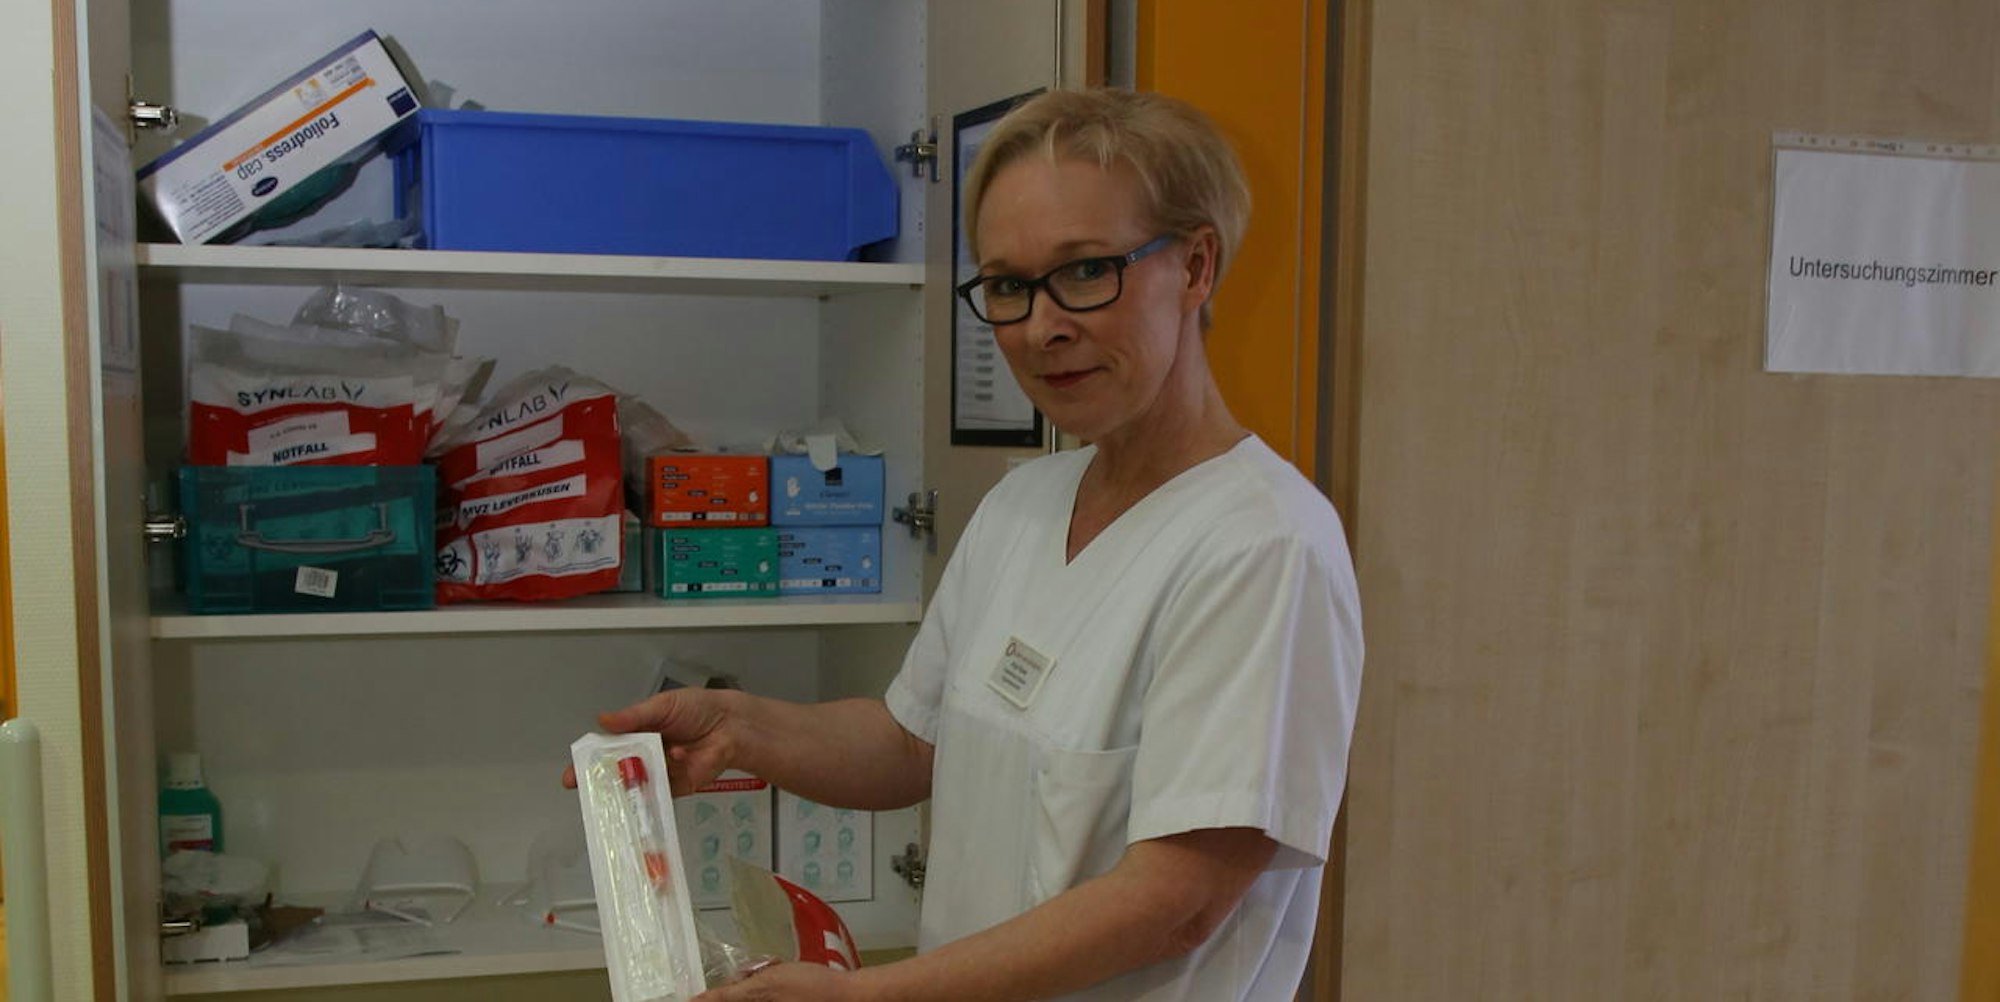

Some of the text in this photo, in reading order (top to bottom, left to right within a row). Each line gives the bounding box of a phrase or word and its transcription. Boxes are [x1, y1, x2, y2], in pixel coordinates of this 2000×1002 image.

[236, 111, 340, 181] Foliodress cap
[1789, 255, 1998, 288] Untersuchungszimmer
[237, 386, 336, 407] SYNLAB
[273, 442, 328, 463] NOTFALL
